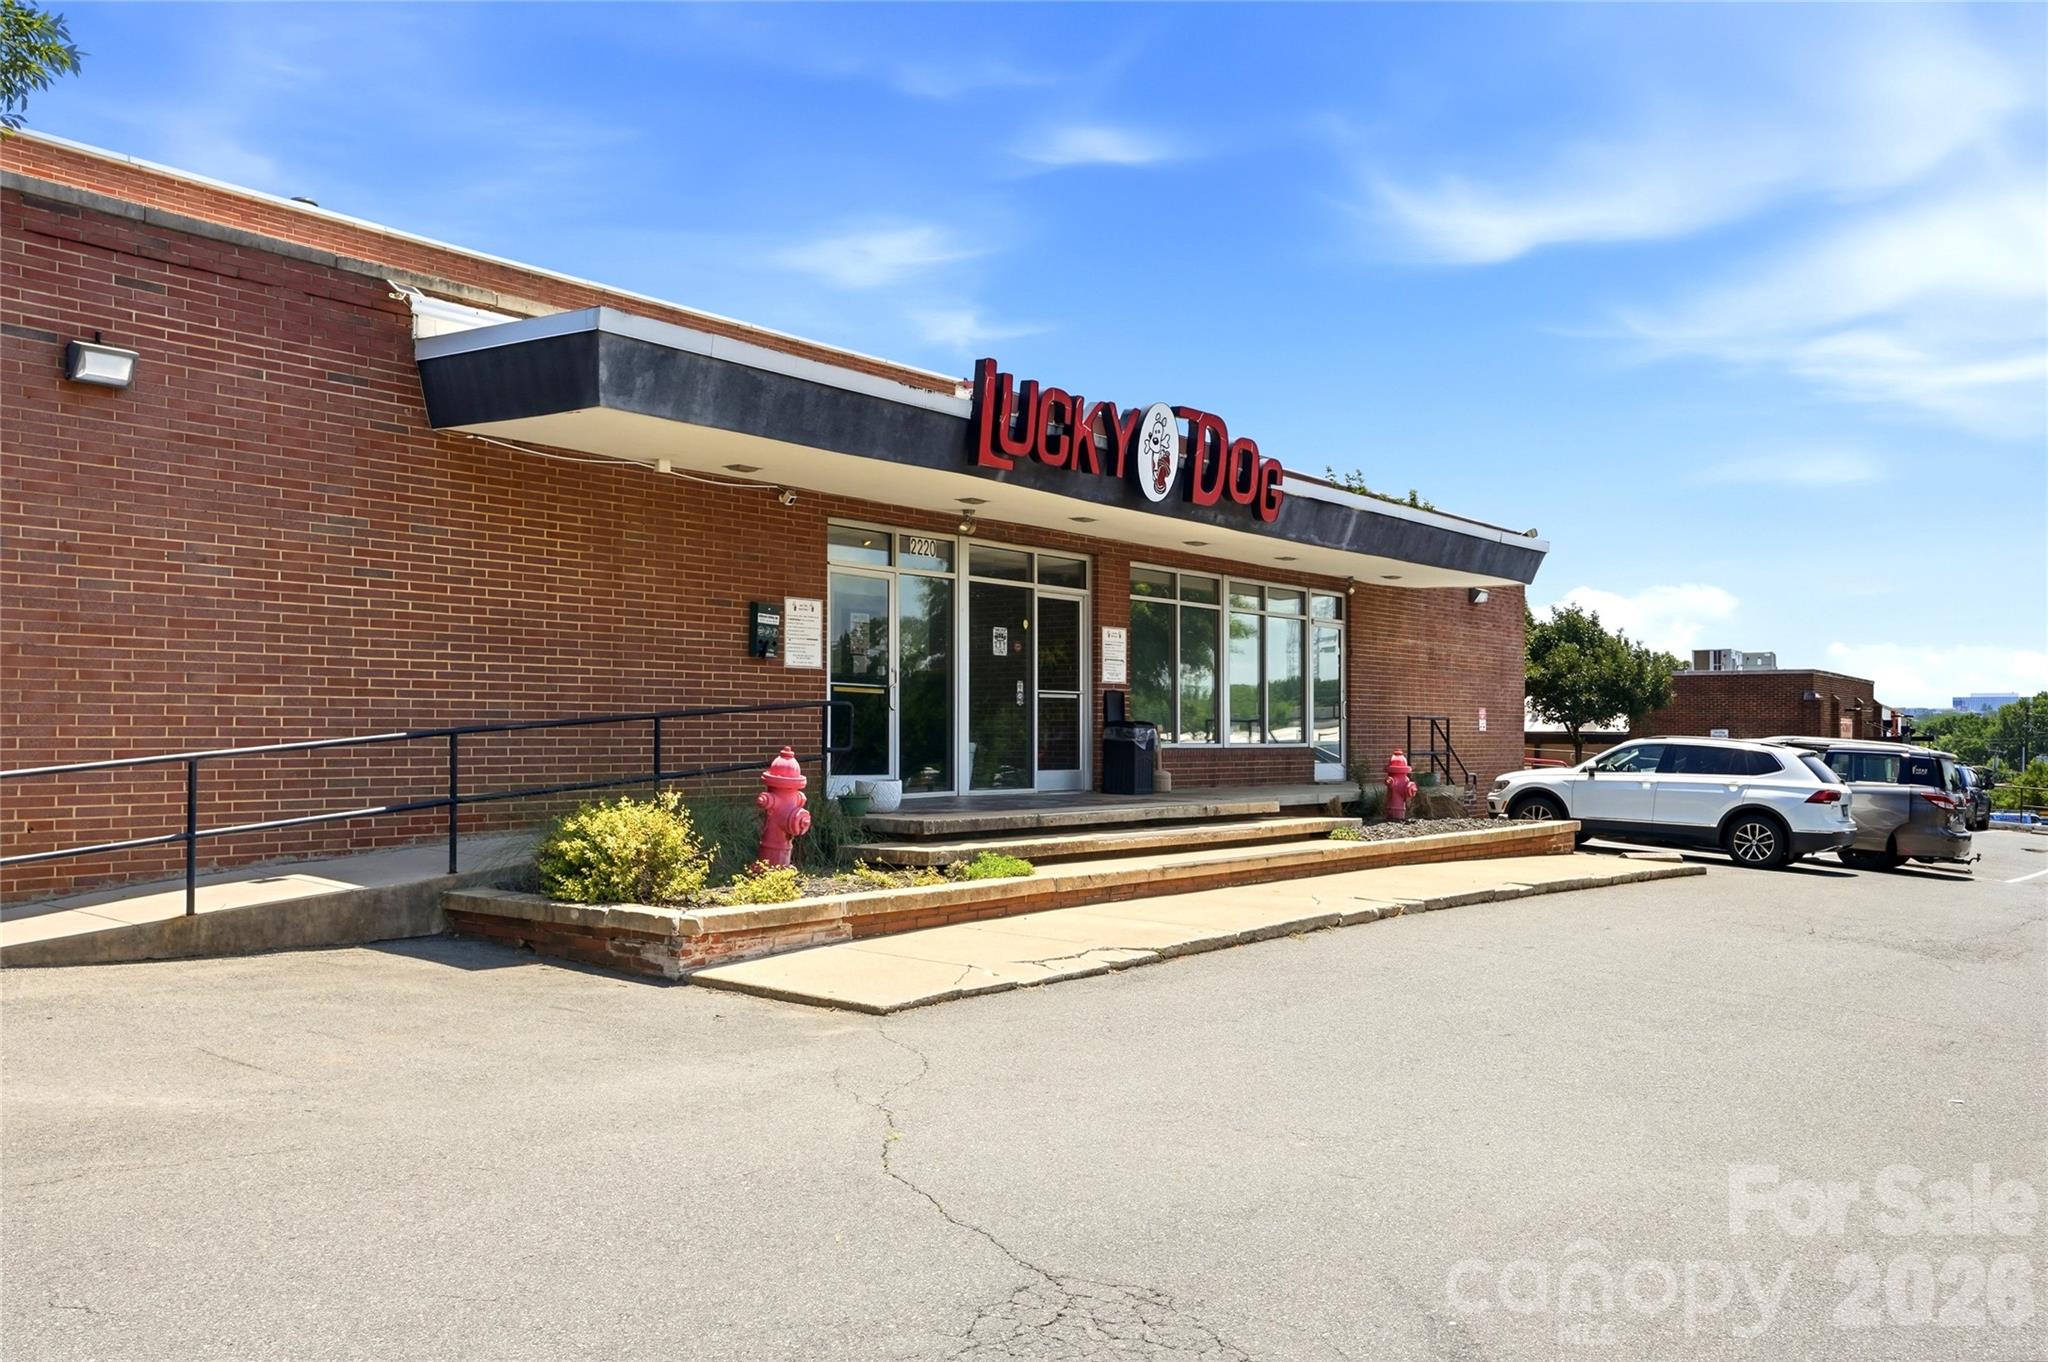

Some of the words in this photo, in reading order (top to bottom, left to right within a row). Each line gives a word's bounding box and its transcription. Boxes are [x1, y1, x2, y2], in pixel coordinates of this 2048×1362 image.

[971, 358, 1140, 478] LUCKY
[1172, 406, 1284, 523] DOG
[911, 538, 936, 557] 2220
